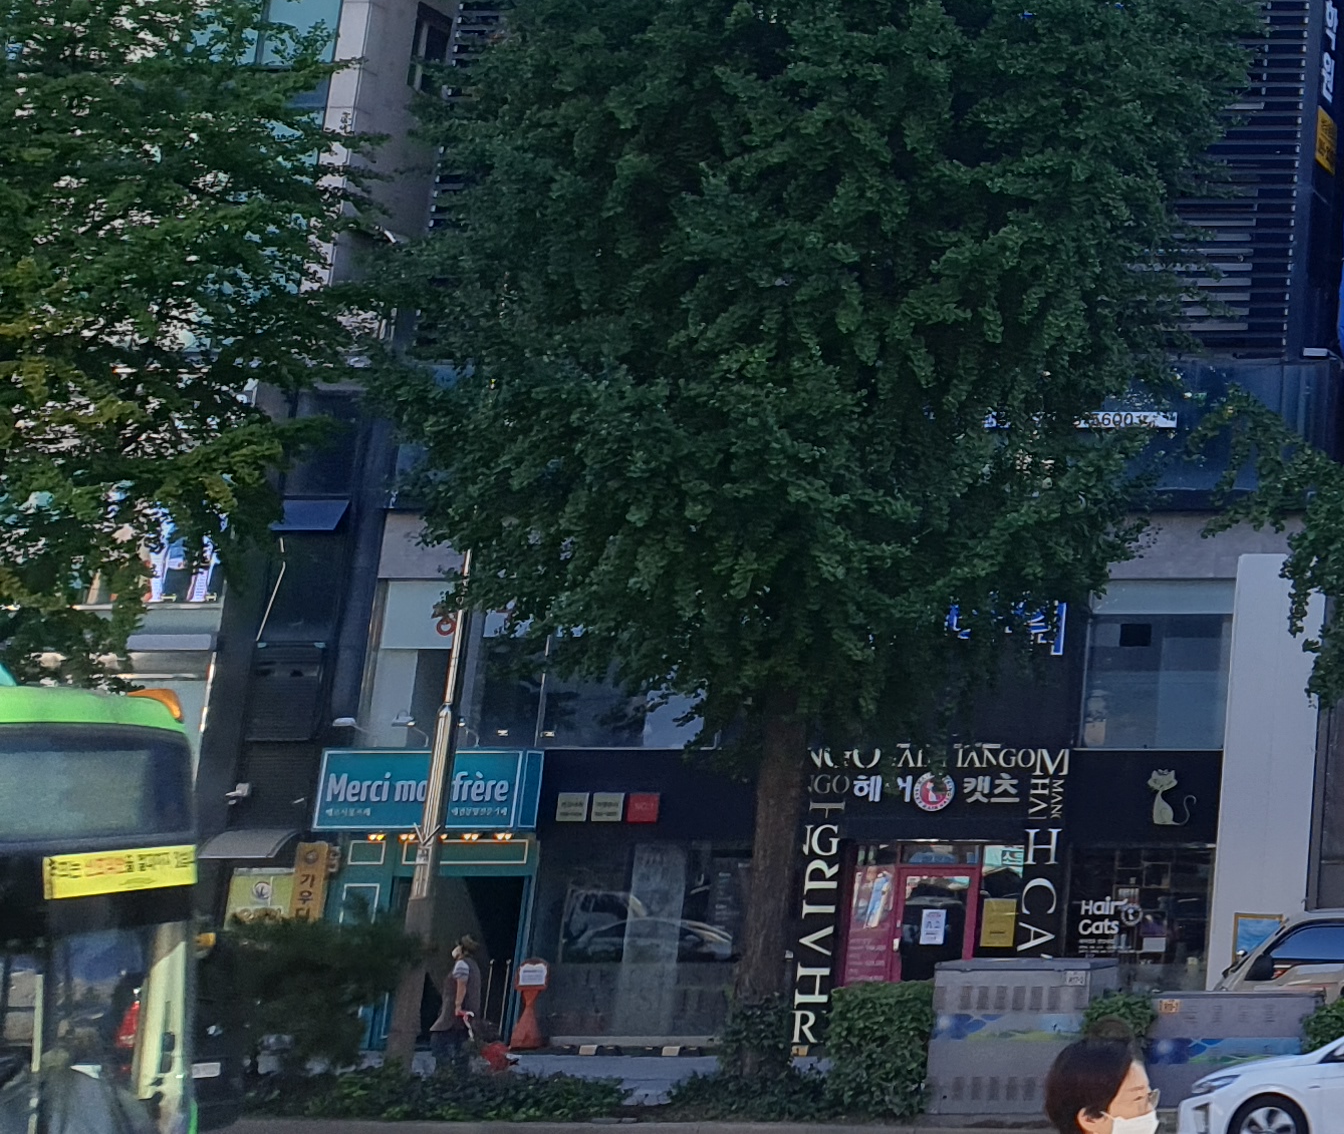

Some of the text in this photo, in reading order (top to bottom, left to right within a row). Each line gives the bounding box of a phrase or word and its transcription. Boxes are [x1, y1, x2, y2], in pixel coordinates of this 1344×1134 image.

[325, 770, 510, 803] Merci mo frère
[962, 772, 1020, 803] 캣츠
[1080, 895, 1129, 916] Hair
[1078, 918, 1120, 935] Cats
